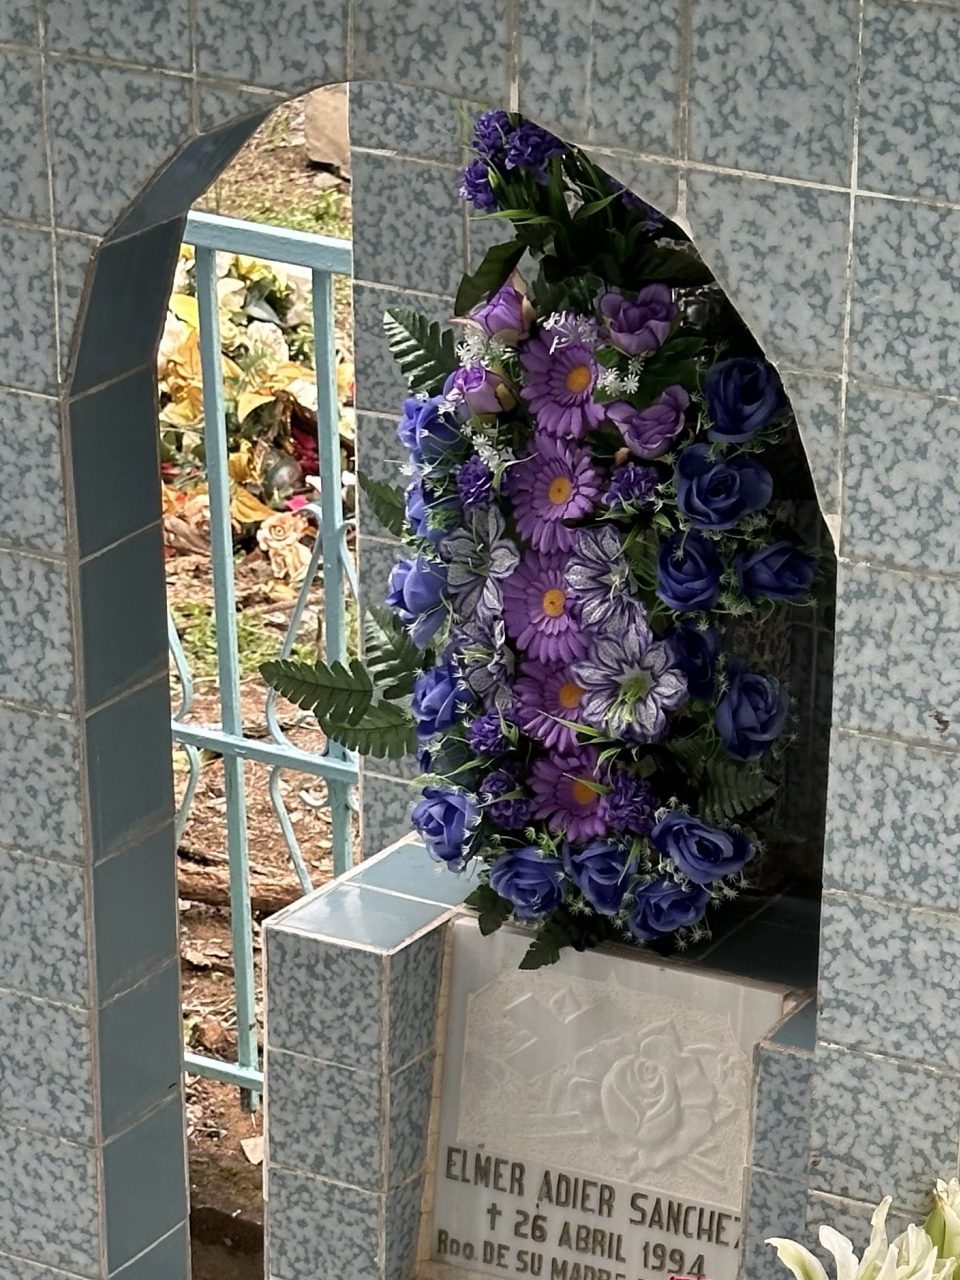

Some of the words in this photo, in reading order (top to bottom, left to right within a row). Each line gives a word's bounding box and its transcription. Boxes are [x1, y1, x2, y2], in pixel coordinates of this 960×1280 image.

[537, 1170, 616, 1218] ADIER
[483, 1240, 510, 1269] DE
[515, 1249, 543, 1277] SU
[514, 1209, 548, 1243] 26
[558, 1220, 626, 1264] ABRIL
[642, 1240, 706, 1280] 1994
